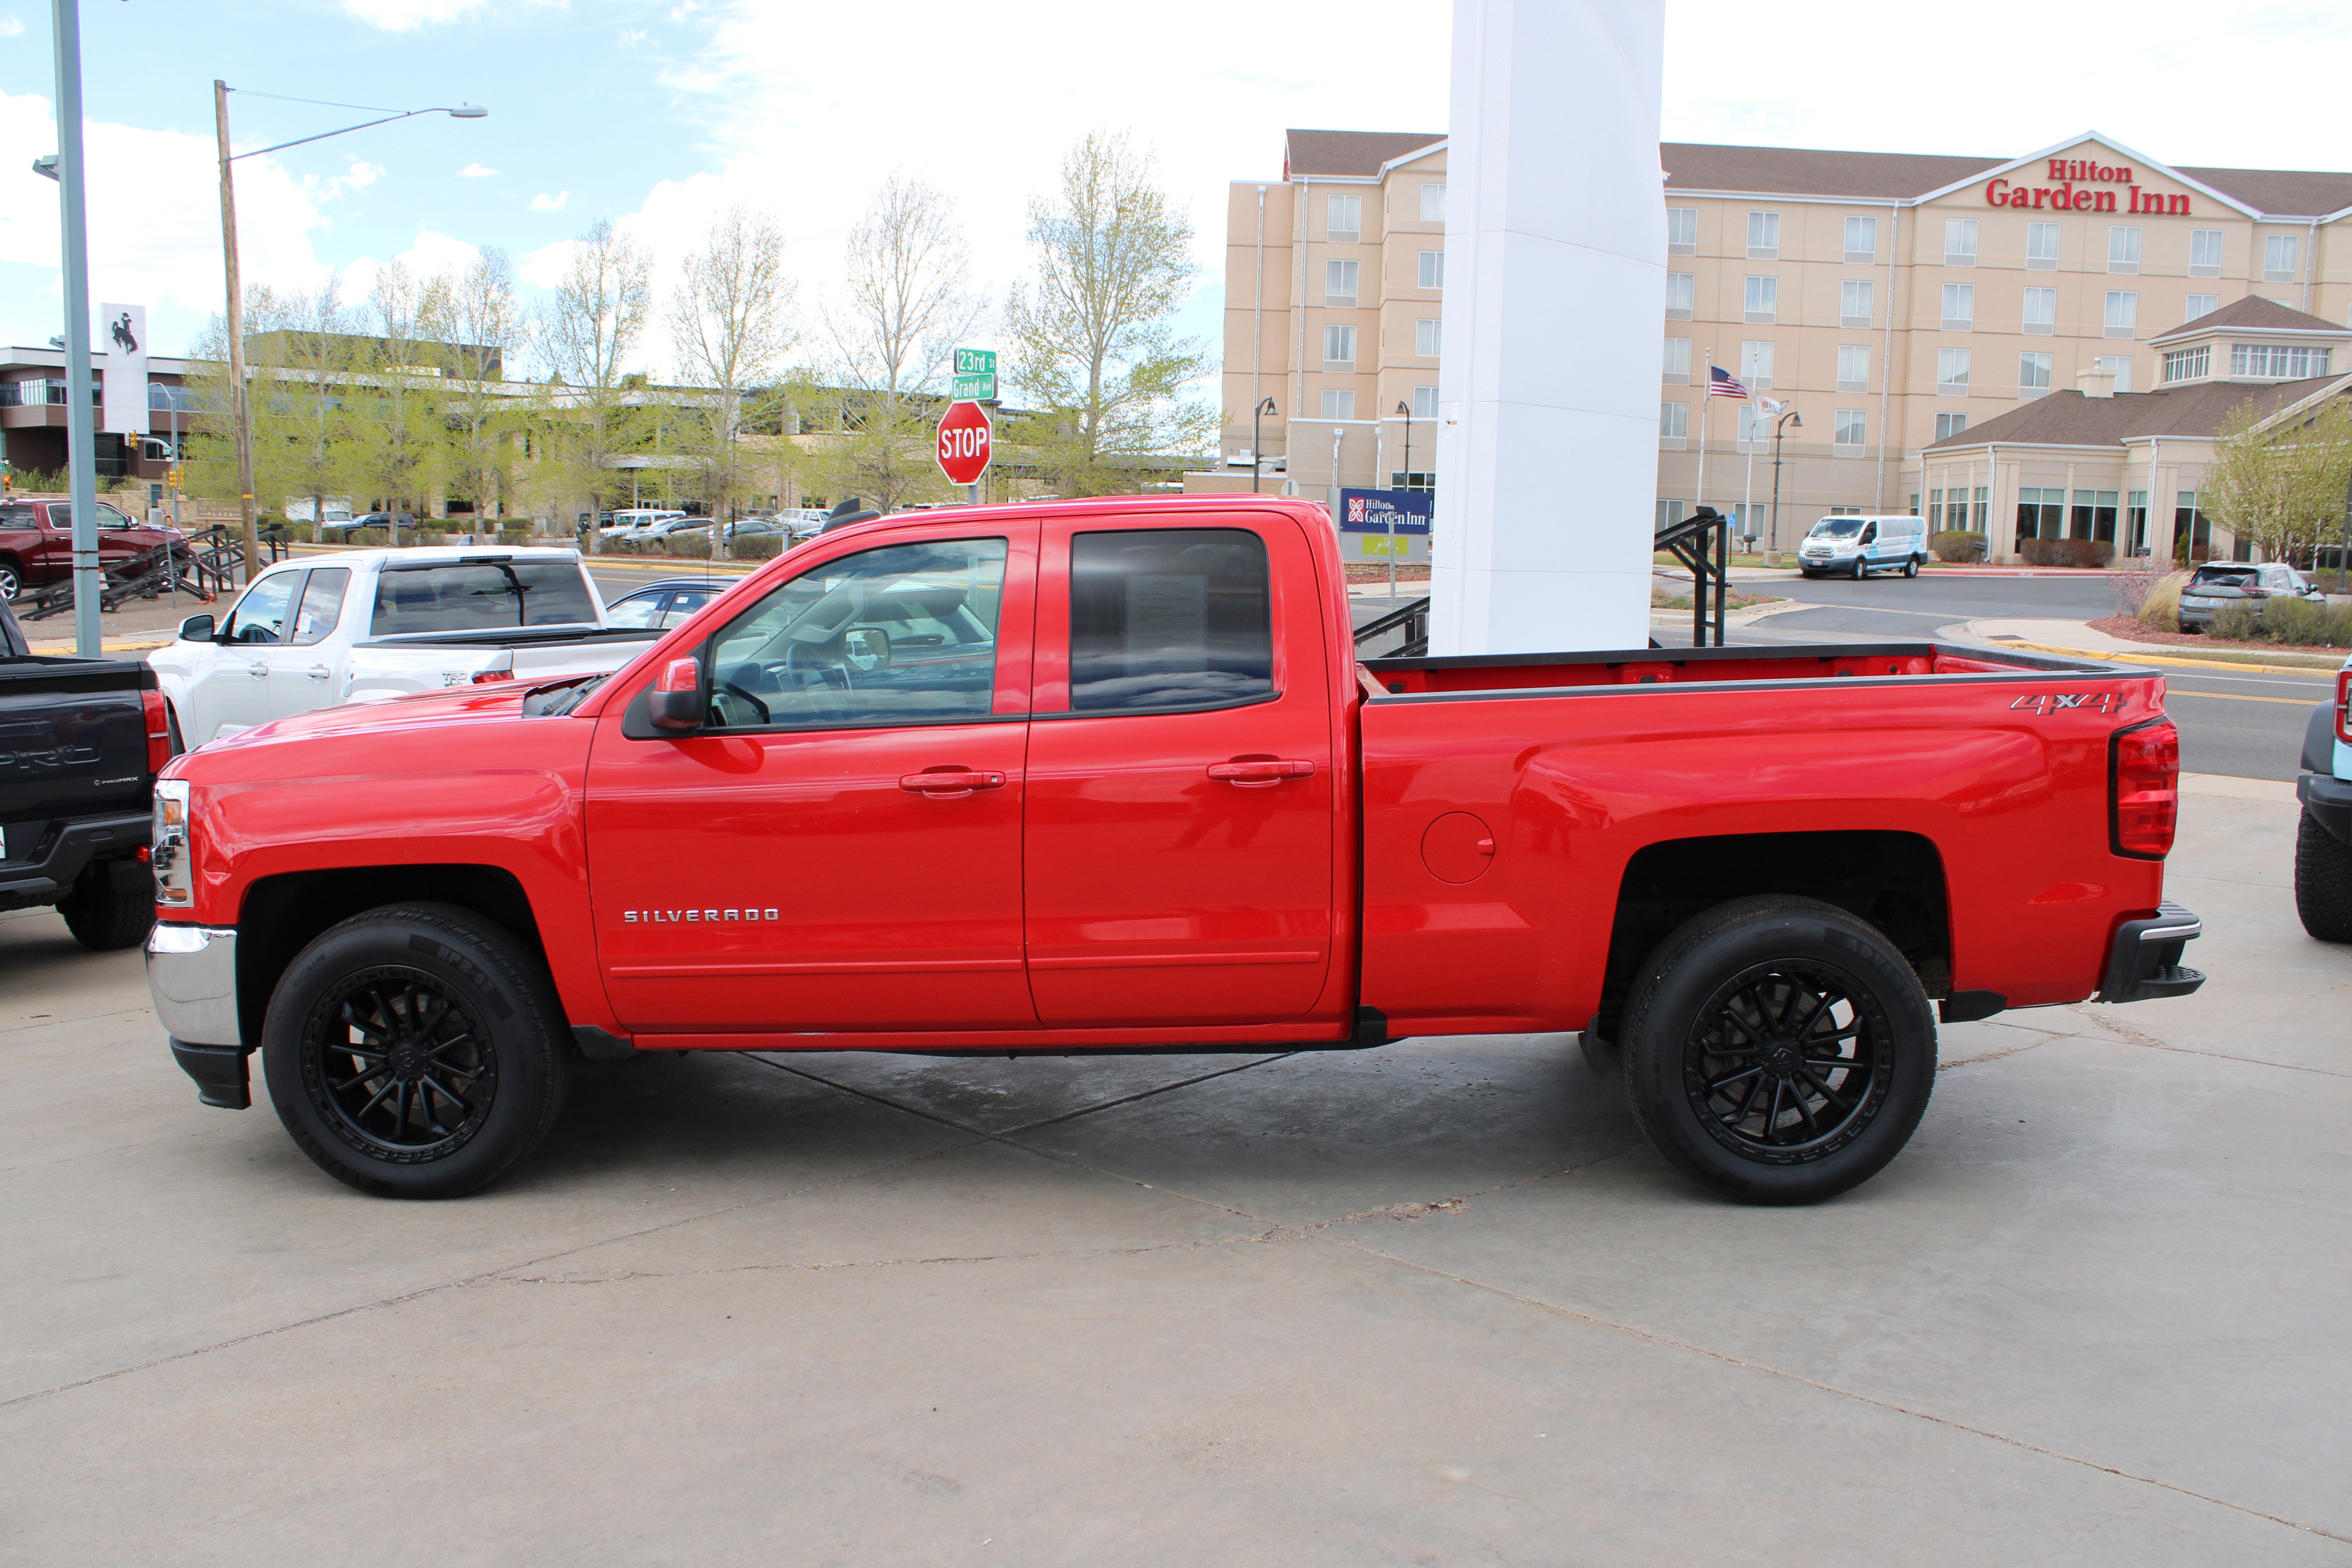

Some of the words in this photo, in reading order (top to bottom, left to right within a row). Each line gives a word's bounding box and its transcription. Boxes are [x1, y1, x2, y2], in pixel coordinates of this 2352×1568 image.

[2048, 159, 2133, 182] Hilton
[1987, 178, 2118, 211] Garden
[2127, 185, 2191, 215] Inn
[959, 352, 986, 372] 23rd
[989, 359, 995, 368] St
[953, 378, 979, 398] Grand
[982, 381, 992, 392] Ave
[941, 427, 987, 459] STOP
[1365, 499, 1390, 510] Hilton
[1407, 511, 1426, 526] Inn
[624, 909, 779, 923] SILVERADO
